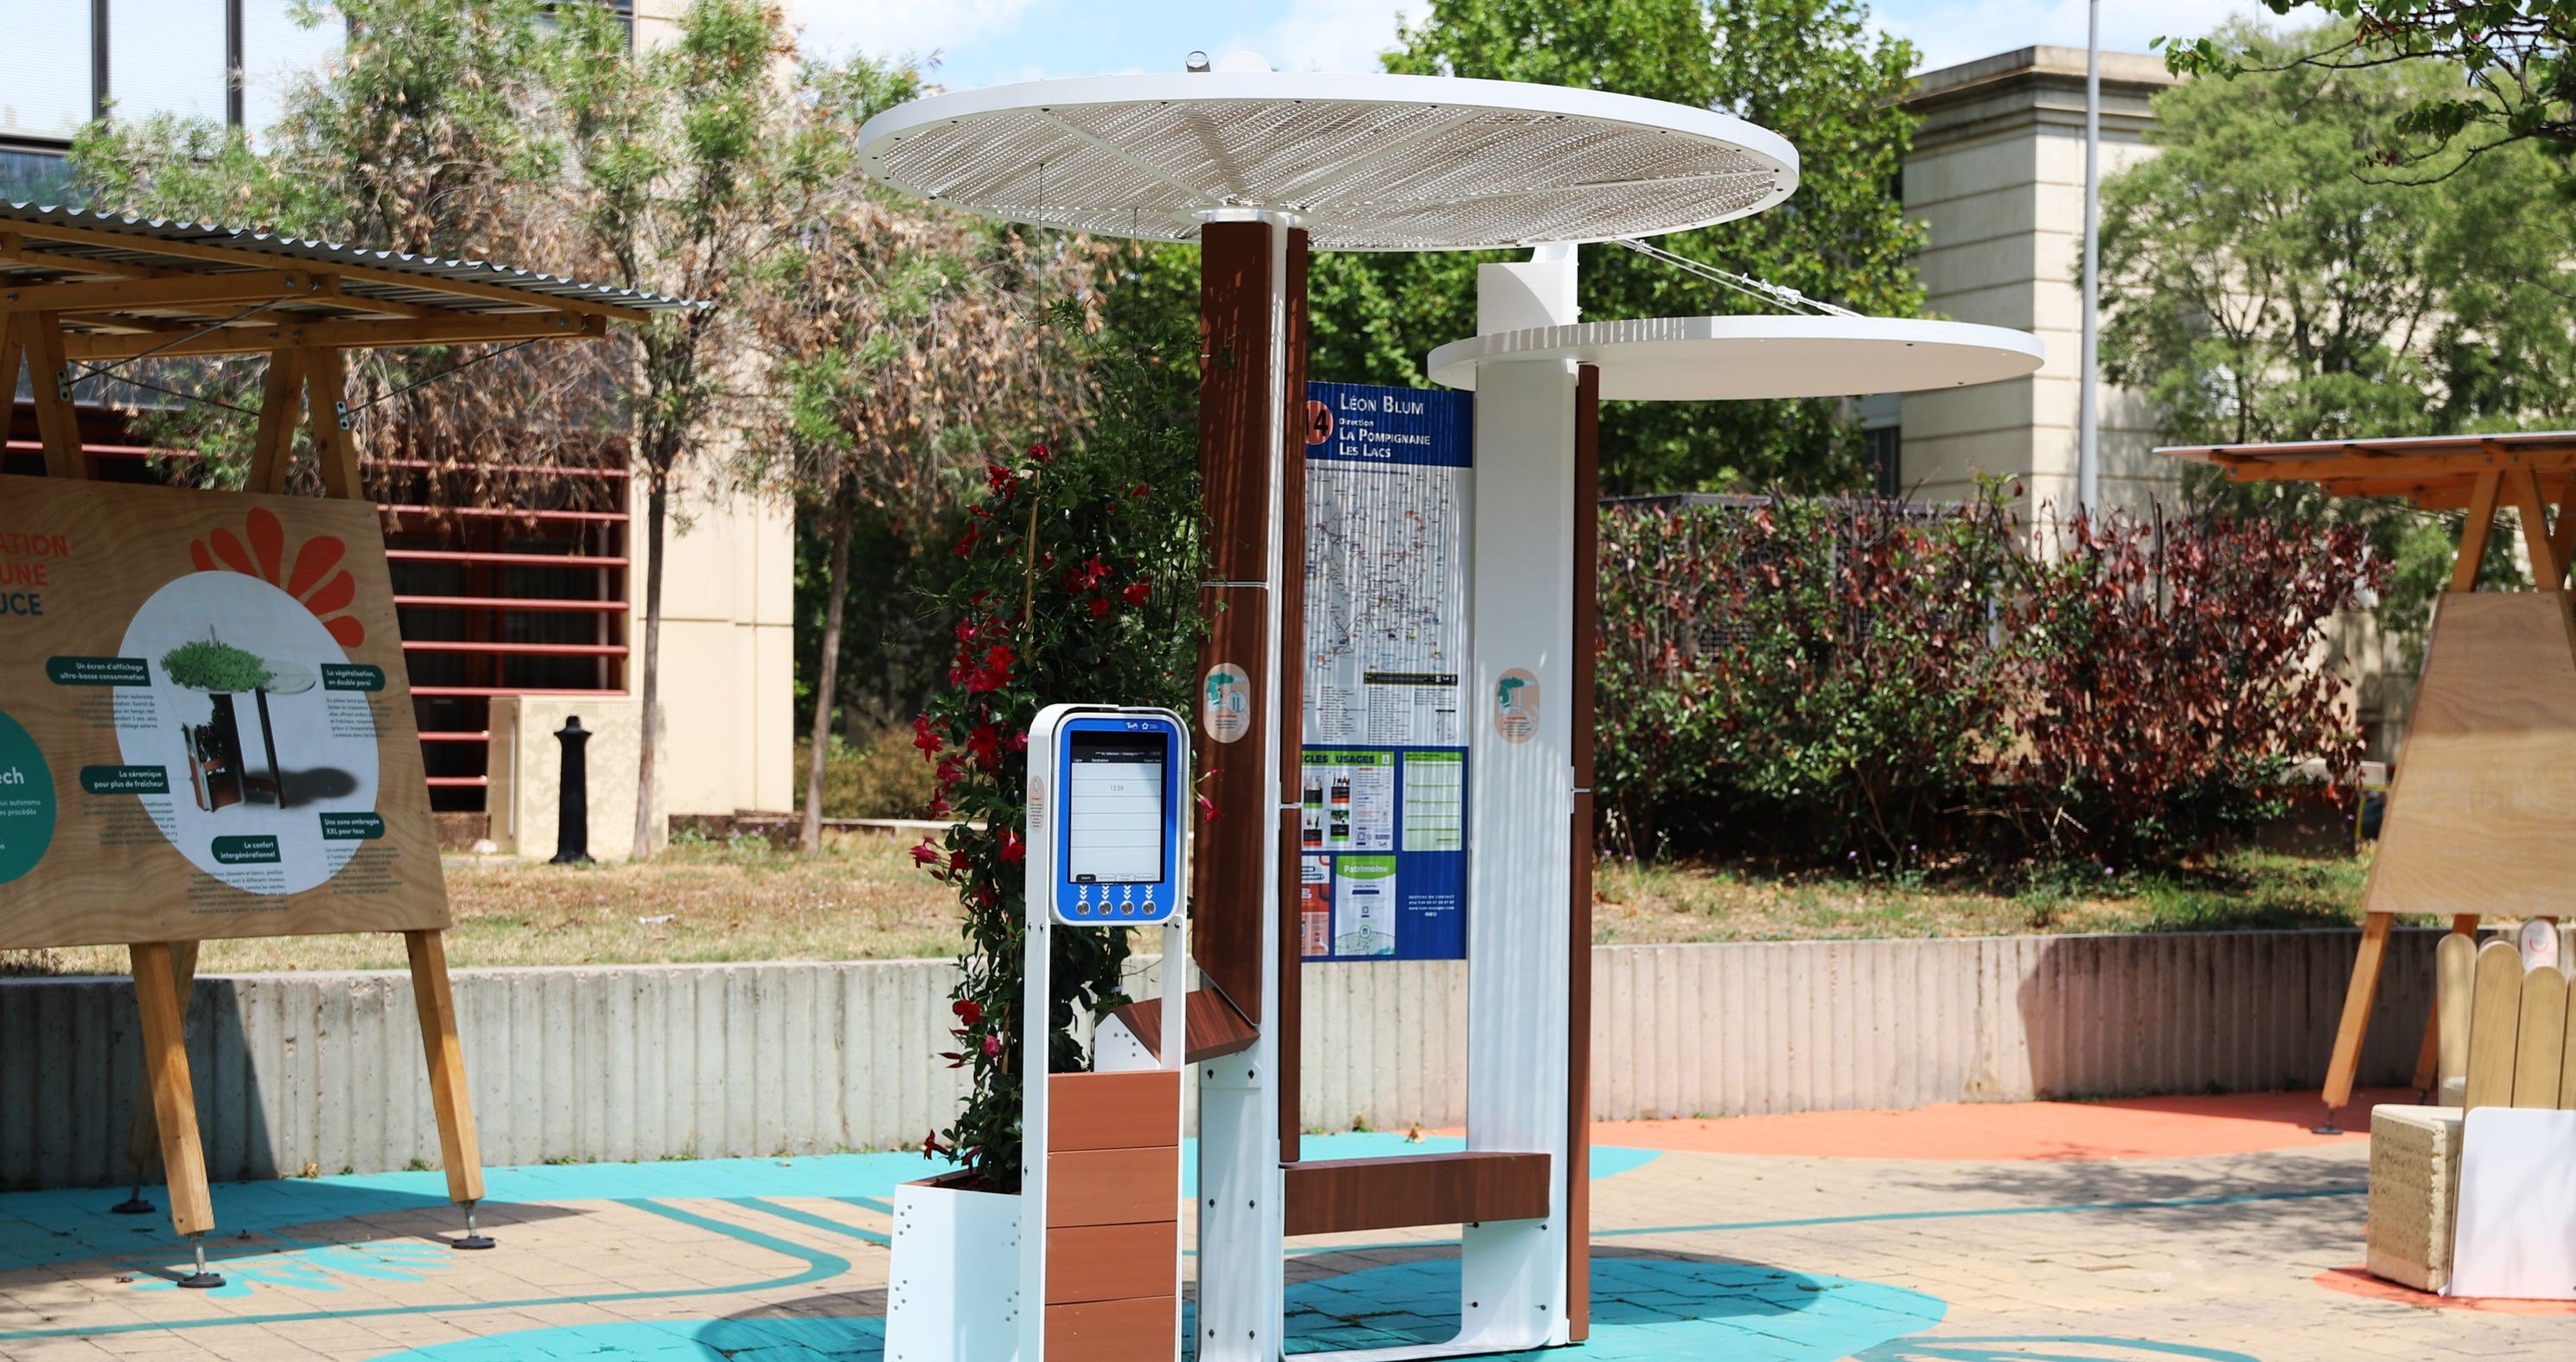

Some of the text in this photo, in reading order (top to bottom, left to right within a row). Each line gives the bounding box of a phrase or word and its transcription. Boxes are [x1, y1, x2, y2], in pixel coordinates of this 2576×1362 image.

[1340, 393, 1424, 415] LÉON BLUM
[1339, 417, 1374, 427] Direction
[1339, 428, 1431, 445] LA POMPIGNANE
[1339, 442, 1392, 458] LES LACS
[106, 663, 143, 672] d'affichage
[1303, 754, 1329, 763] GLES
[0, 767, 24, 785] ch
[128, 771, 162, 780] céramique
[111, 780, 124, 789] plus
[220, 850, 276, 861] intergénérationnel
[1343, 865, 1388, 874] Patrimoine
